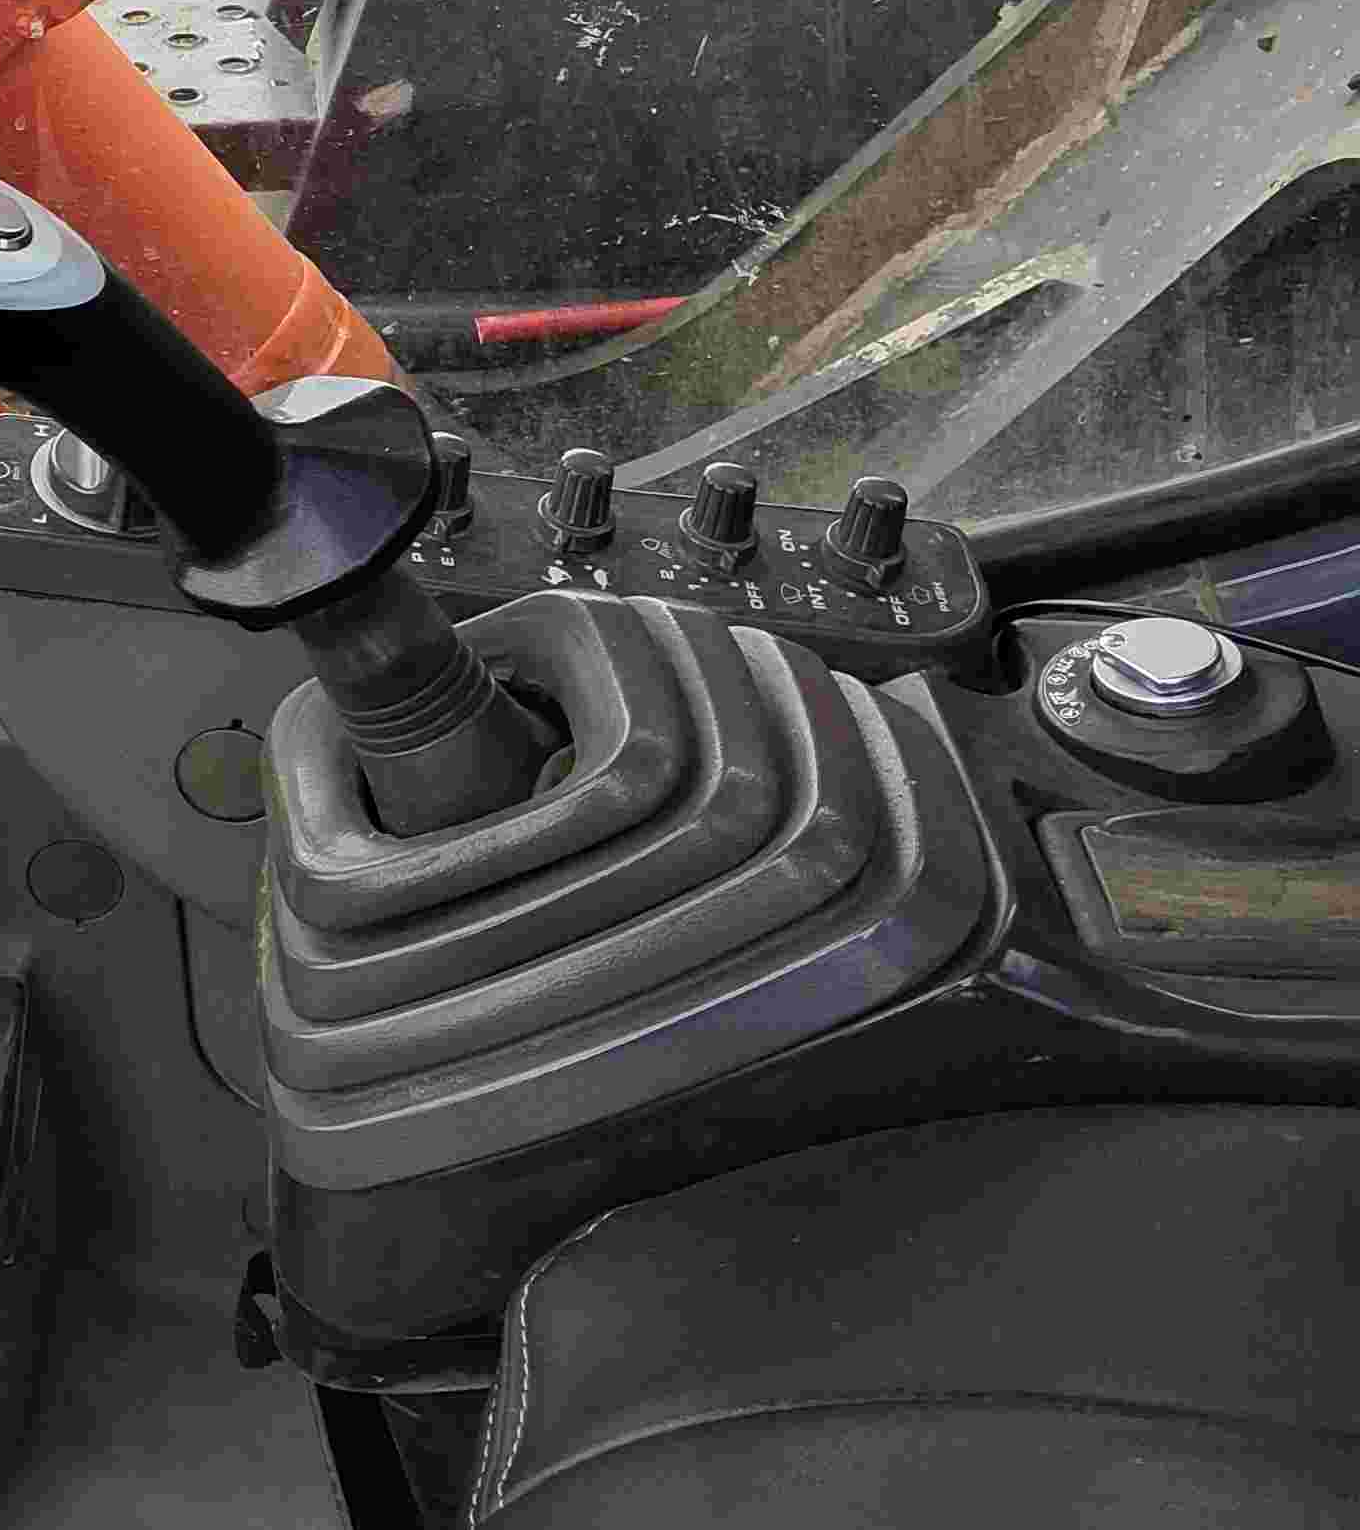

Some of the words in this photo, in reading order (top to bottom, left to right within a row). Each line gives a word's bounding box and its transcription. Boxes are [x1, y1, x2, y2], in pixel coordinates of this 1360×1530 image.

[778, 529, 796, 553] ON
[744, 580, 766, 610] OFF
[806, 583, 828, 610] INT
[888, 595, 911, 627] OFF
